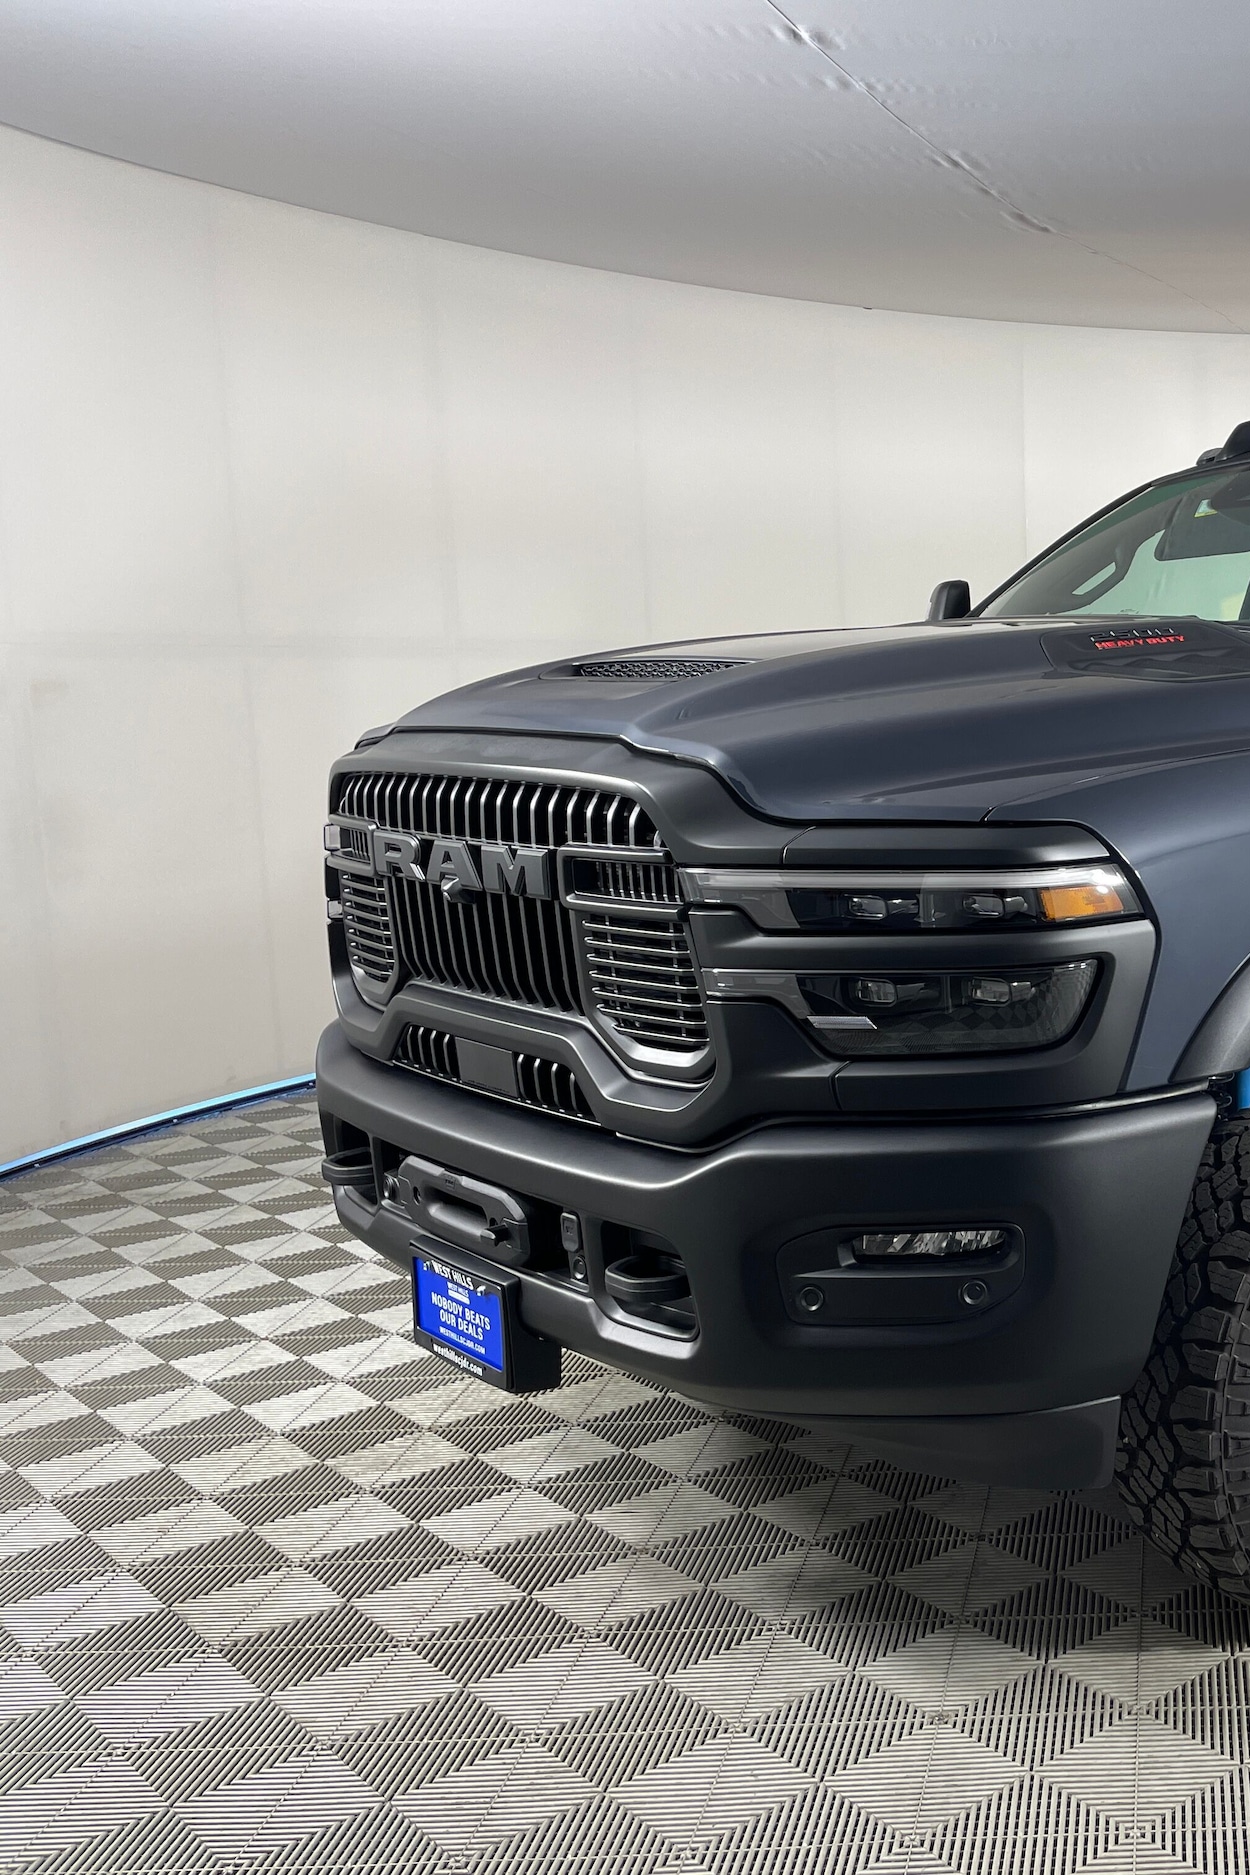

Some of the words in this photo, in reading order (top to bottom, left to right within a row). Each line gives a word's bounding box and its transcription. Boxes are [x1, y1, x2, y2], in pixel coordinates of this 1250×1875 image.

[1095, 639, 1144, 650] HEAVY
[1145, 635, 1185, 645] DUTY
[373, 828, 550, 900] RAM
[431, 1260, 452, 1280] WEST
[451, 1270, 474, 1291] HILLS
[431, 1292, 463, 1318] NOBODY
[465, 1307, 492, 1331] BEATS
[439, 1309, 457, 1328] OUR
[458, 1319, 484, 1341] DEALS
